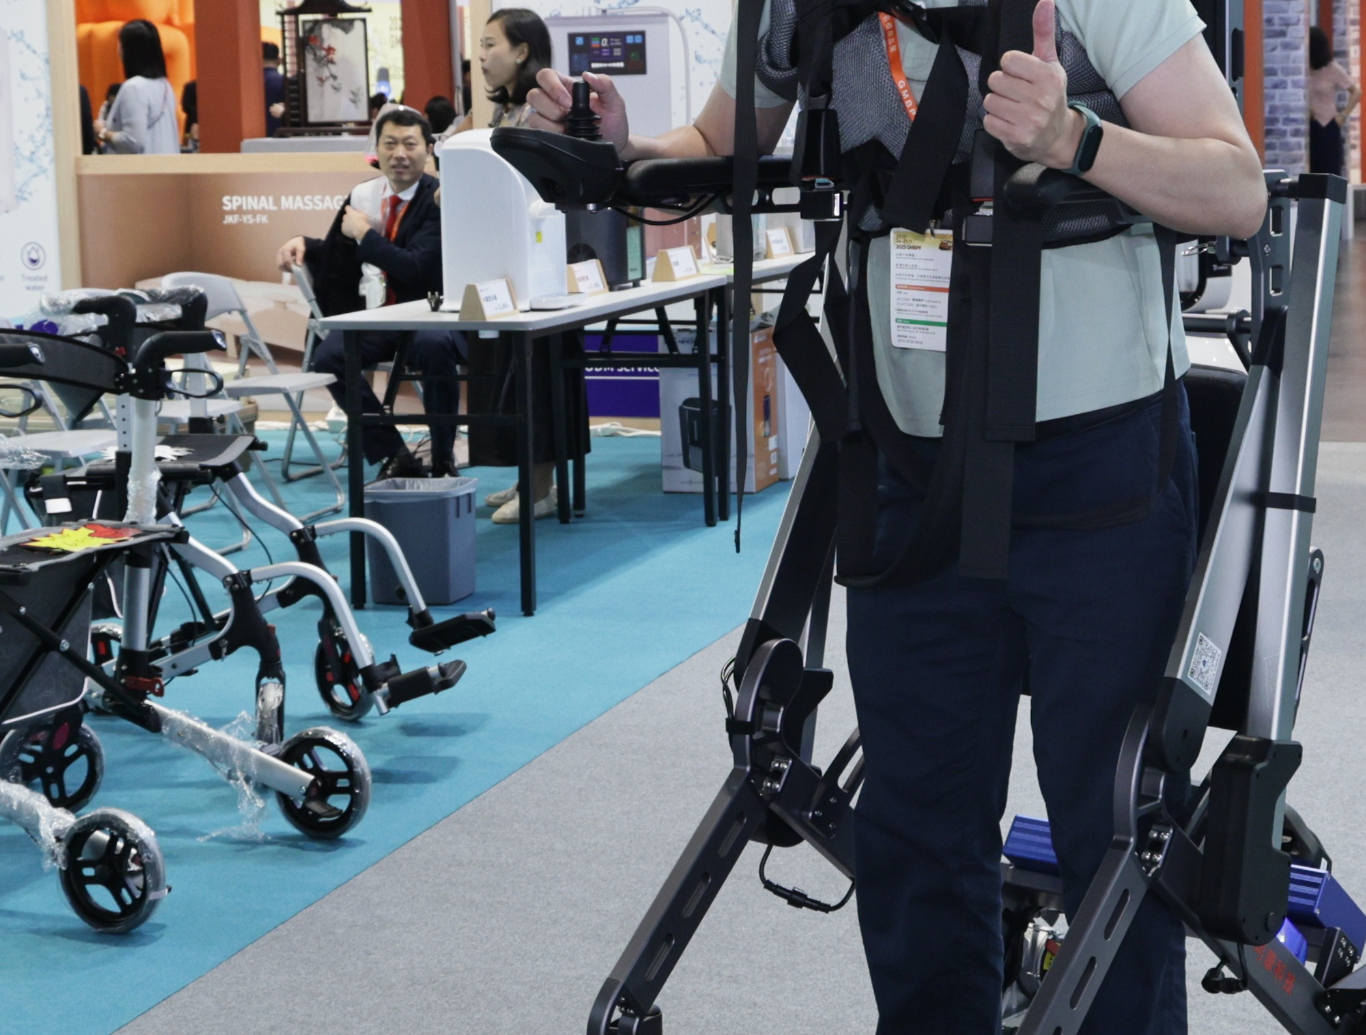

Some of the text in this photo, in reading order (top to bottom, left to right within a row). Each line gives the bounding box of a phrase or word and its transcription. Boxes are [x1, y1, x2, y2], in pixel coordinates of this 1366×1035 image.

[898, 80, 916, 117] GMBP
[222, 194, 349, 211] SPINAL MASSAG
